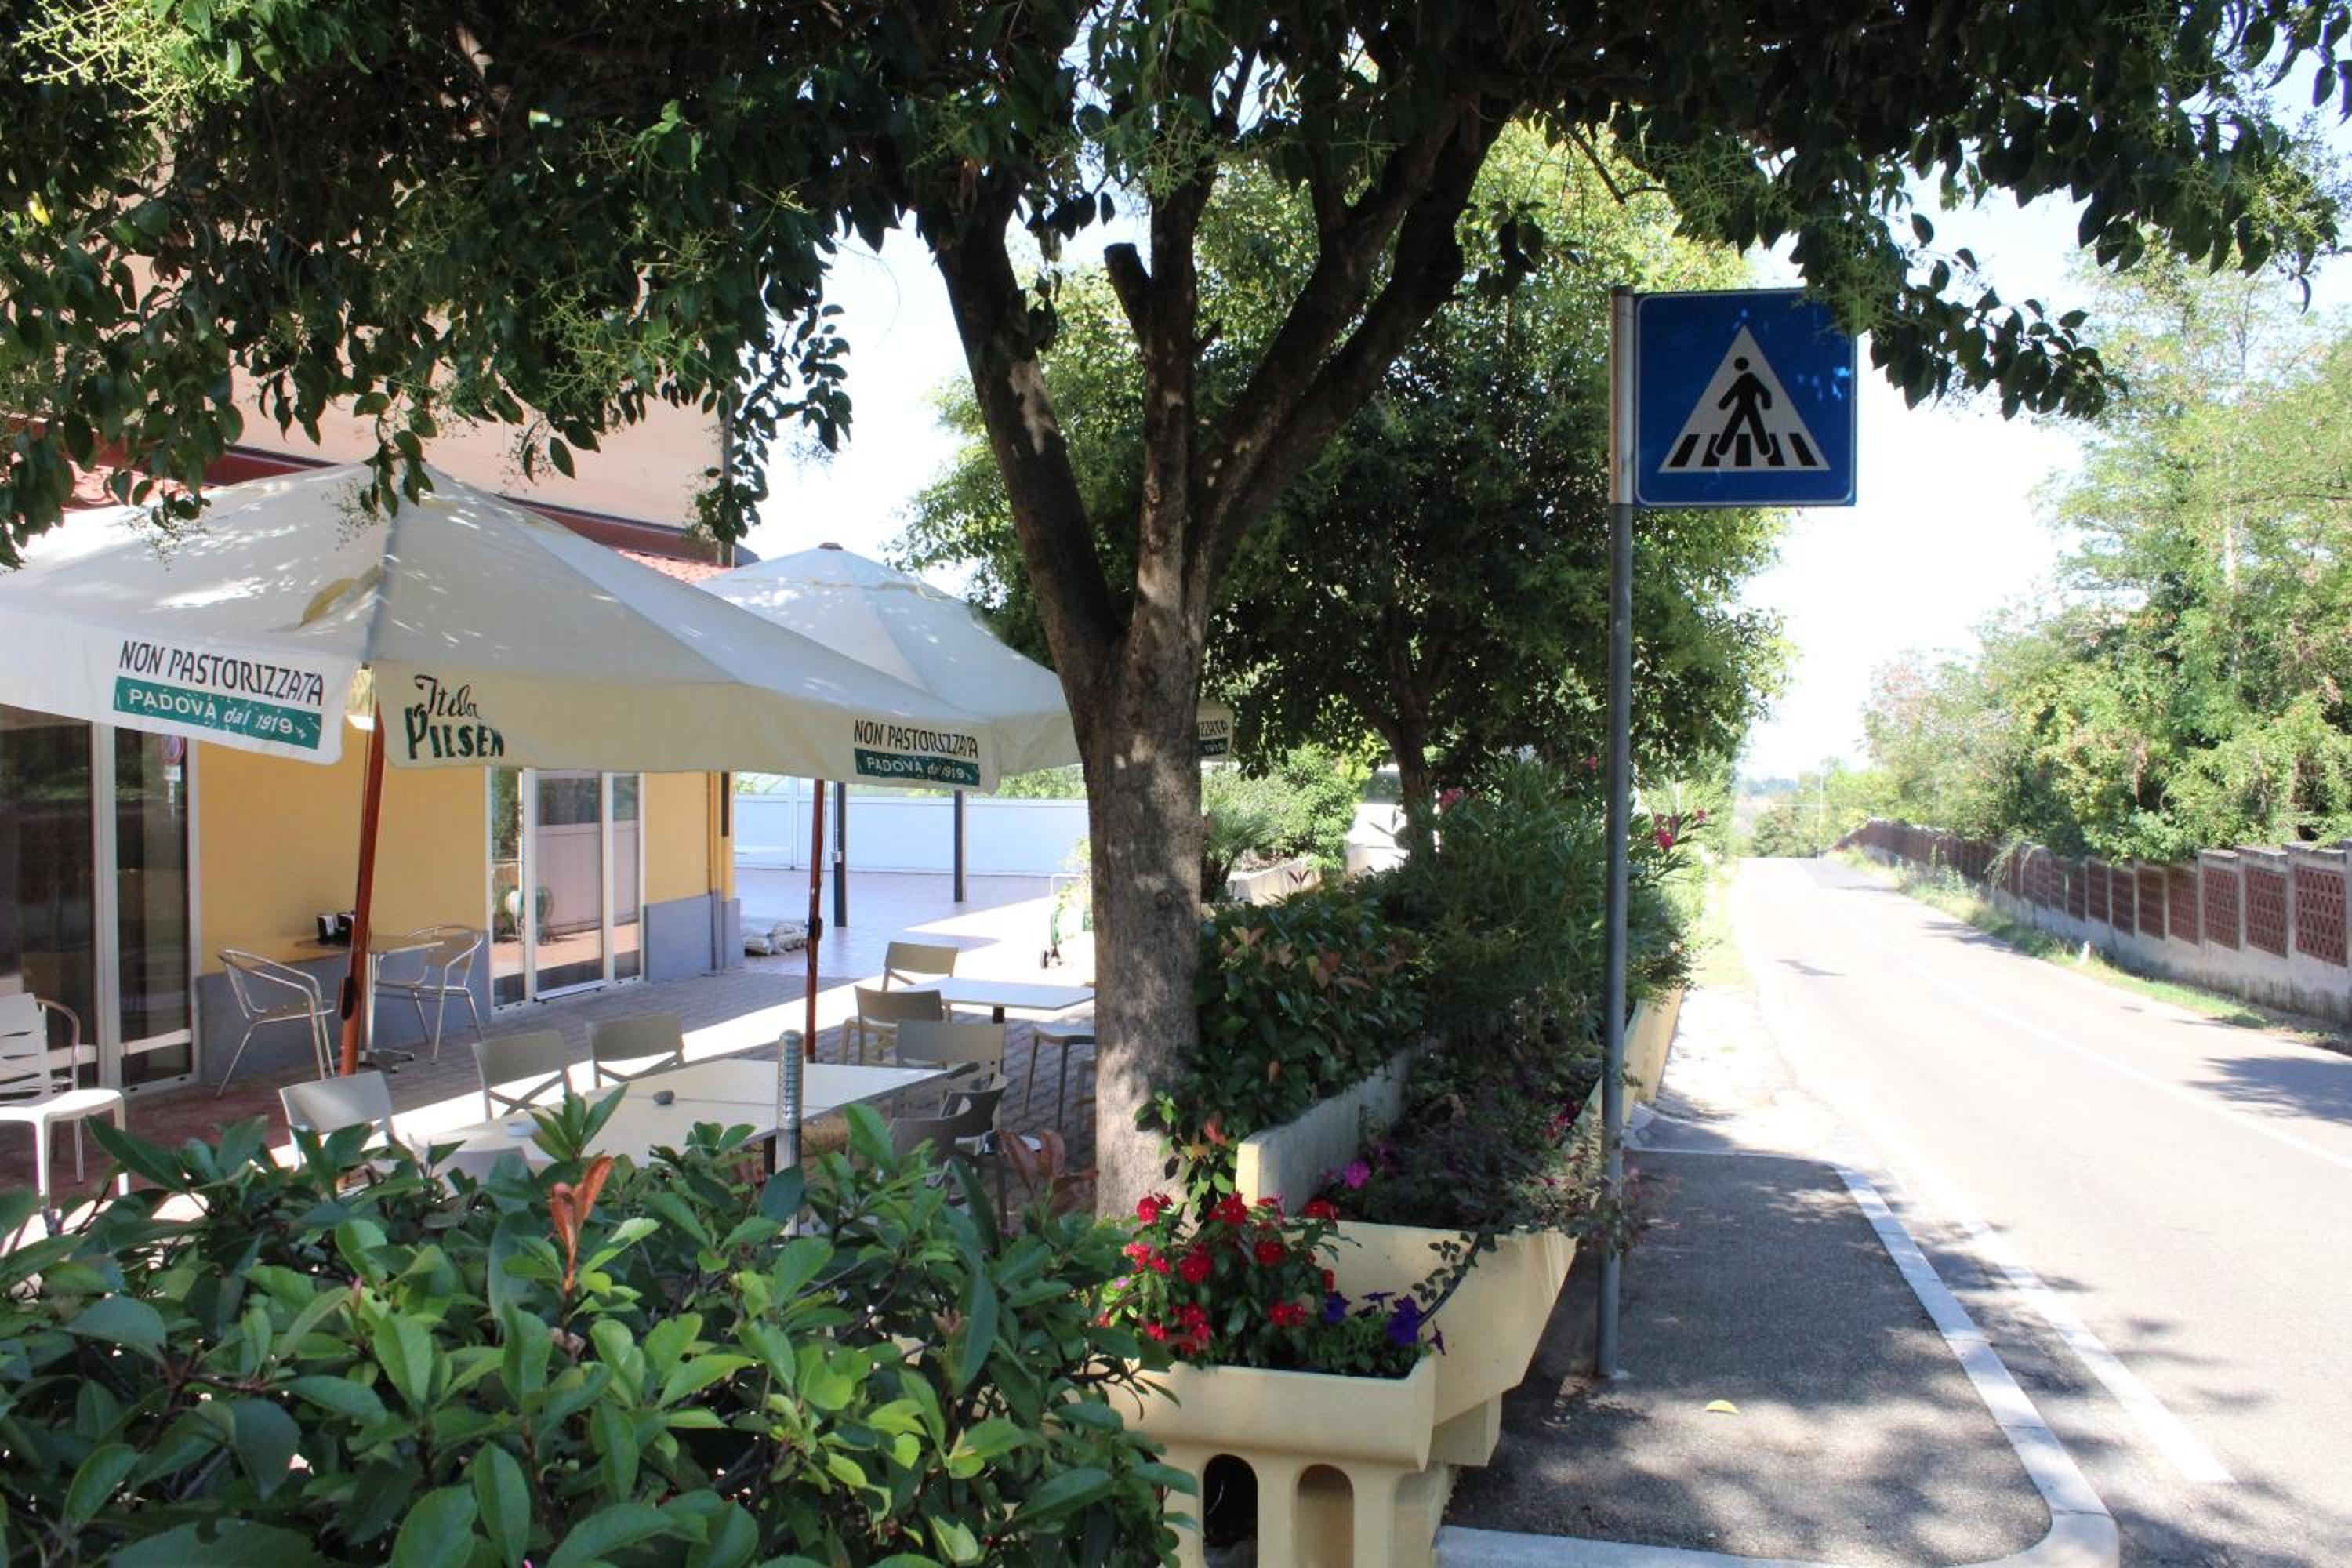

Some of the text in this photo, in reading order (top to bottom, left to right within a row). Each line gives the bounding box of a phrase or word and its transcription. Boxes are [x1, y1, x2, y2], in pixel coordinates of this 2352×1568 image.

[119, 640, 324, 706] NON PASTORIZZATA
[128, 688, 293, 735] PADOVA dal 1919
[404, 706, 505, 760] PILSEN
[854, 719, 884, 746] NON
[866, 757, 924, 774] PADOVA
